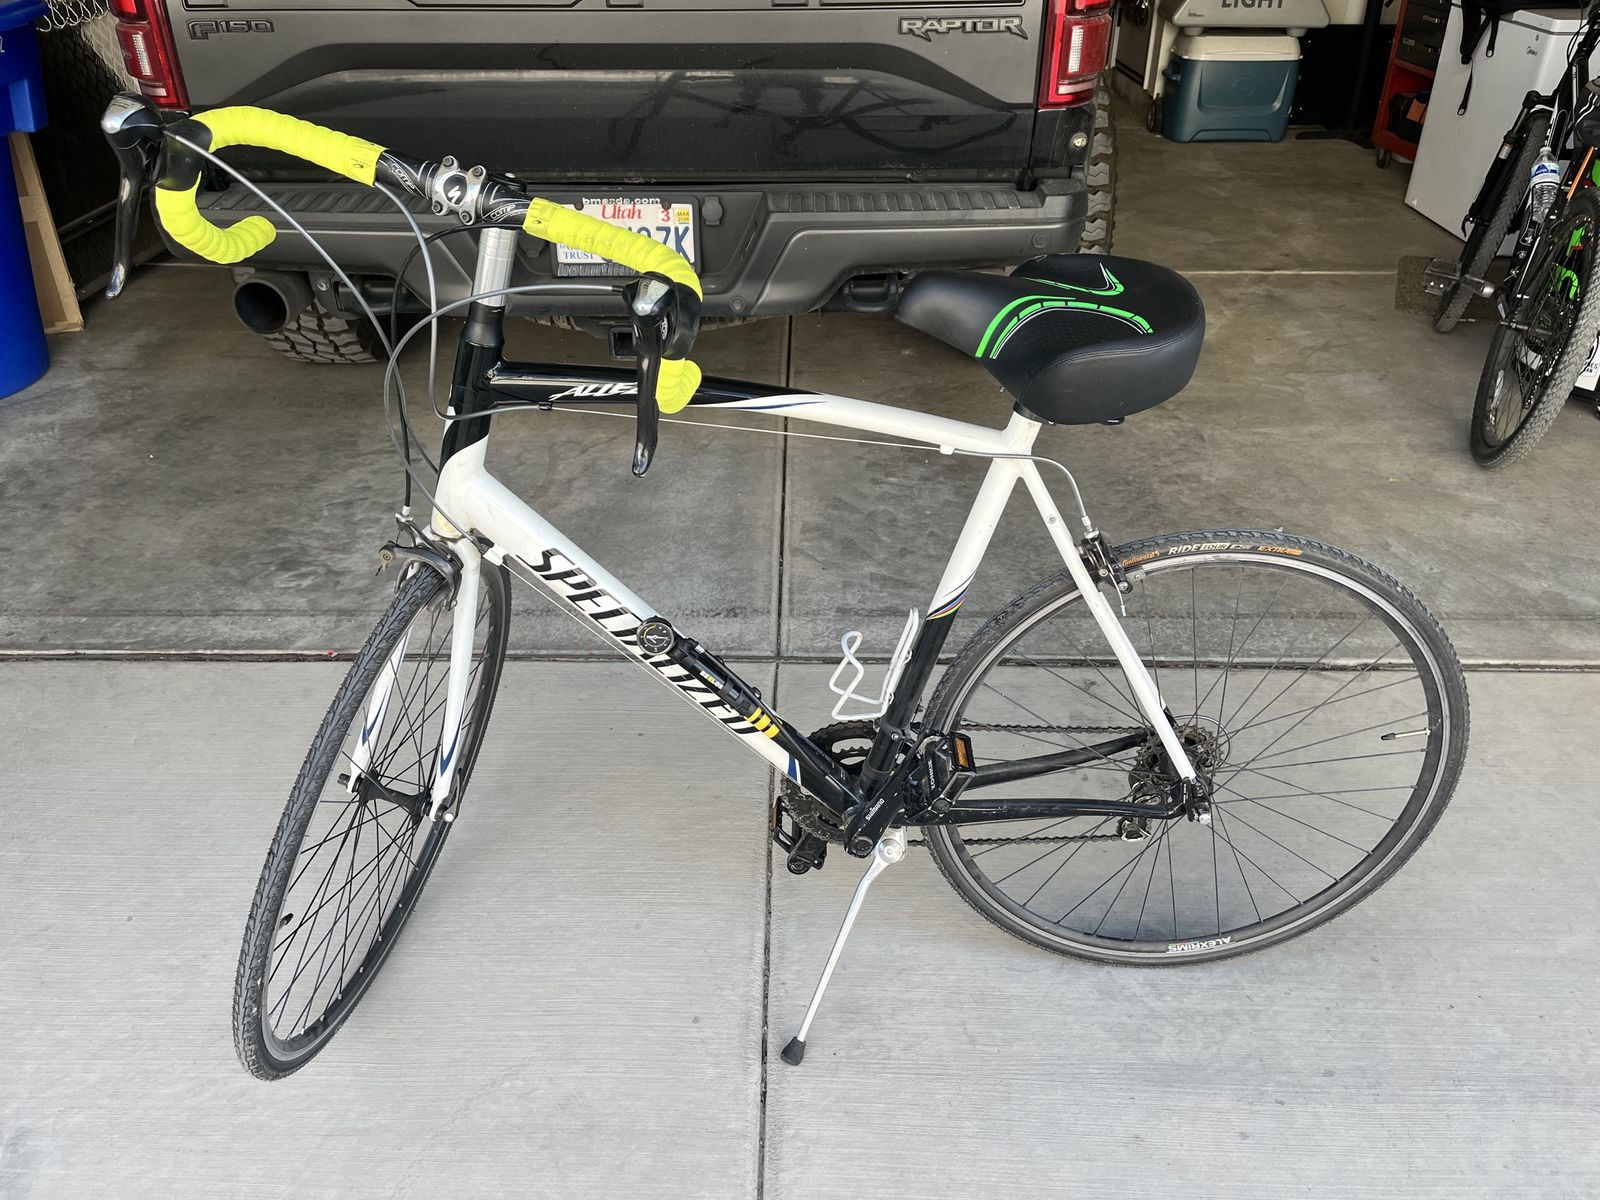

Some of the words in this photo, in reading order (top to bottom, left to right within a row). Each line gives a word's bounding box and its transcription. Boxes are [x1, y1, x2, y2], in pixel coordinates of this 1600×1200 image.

[188, 19, 274, 40] F150
[898, 15, 1028, 42] RAPTOR
[601, 203, 643, 220] Utah
[661, 210, 671, 223] 3
[563, 251, 594, 260] TRUST
[548, 381, 638, 402] ALLE
[1168, 543, 1201, 555] RIDE
[1202, 543, 1227, 551] TOUR
[515, 547, 762, 735] SPECILIZED
[1168, 936, 1232, 952] ALEXRIMS
